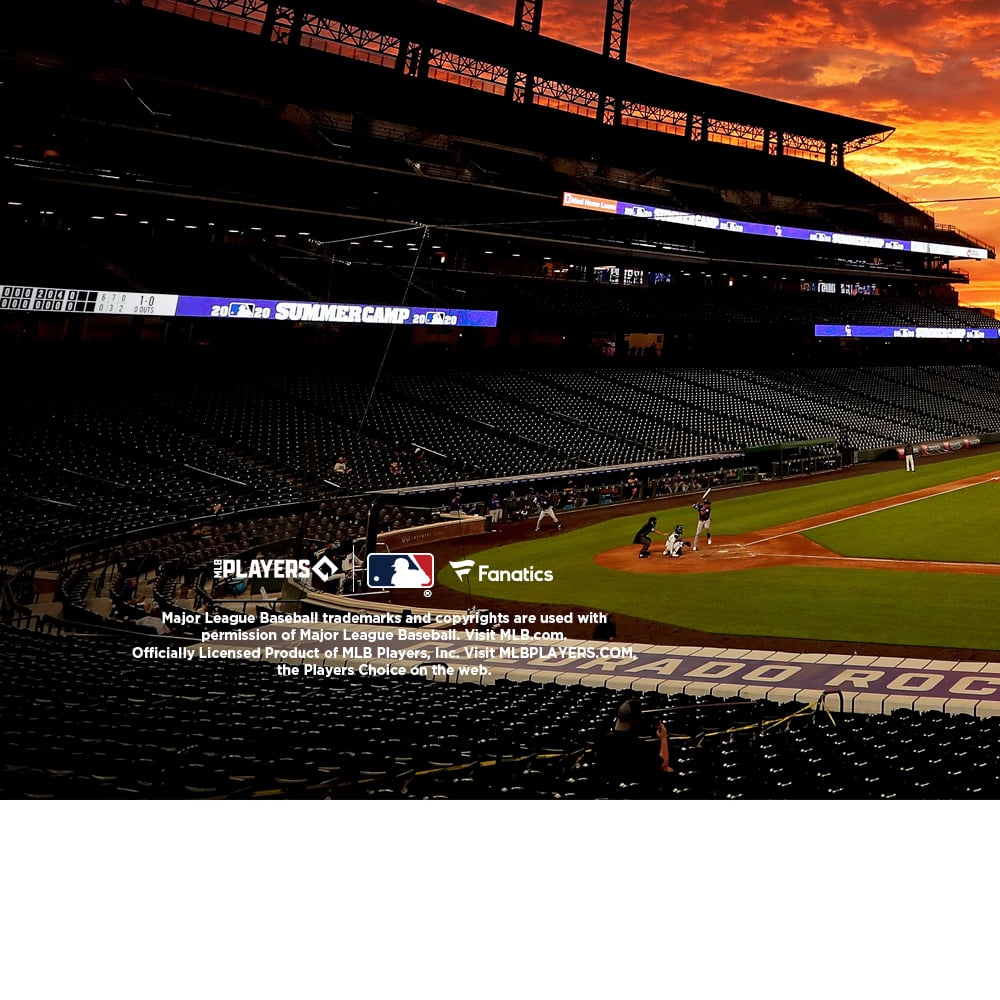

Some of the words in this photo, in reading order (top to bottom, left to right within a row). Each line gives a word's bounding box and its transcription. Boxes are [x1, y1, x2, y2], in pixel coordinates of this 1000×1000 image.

[140, 295, 155, 307] 1-0
[140, 306, 154, 314] OUTS
[211, 305, 228, 316] 20
[254, 307, 271, 318] 20
[412, 313, 426, 324] 20
[444, 314, 458, 326] 20
